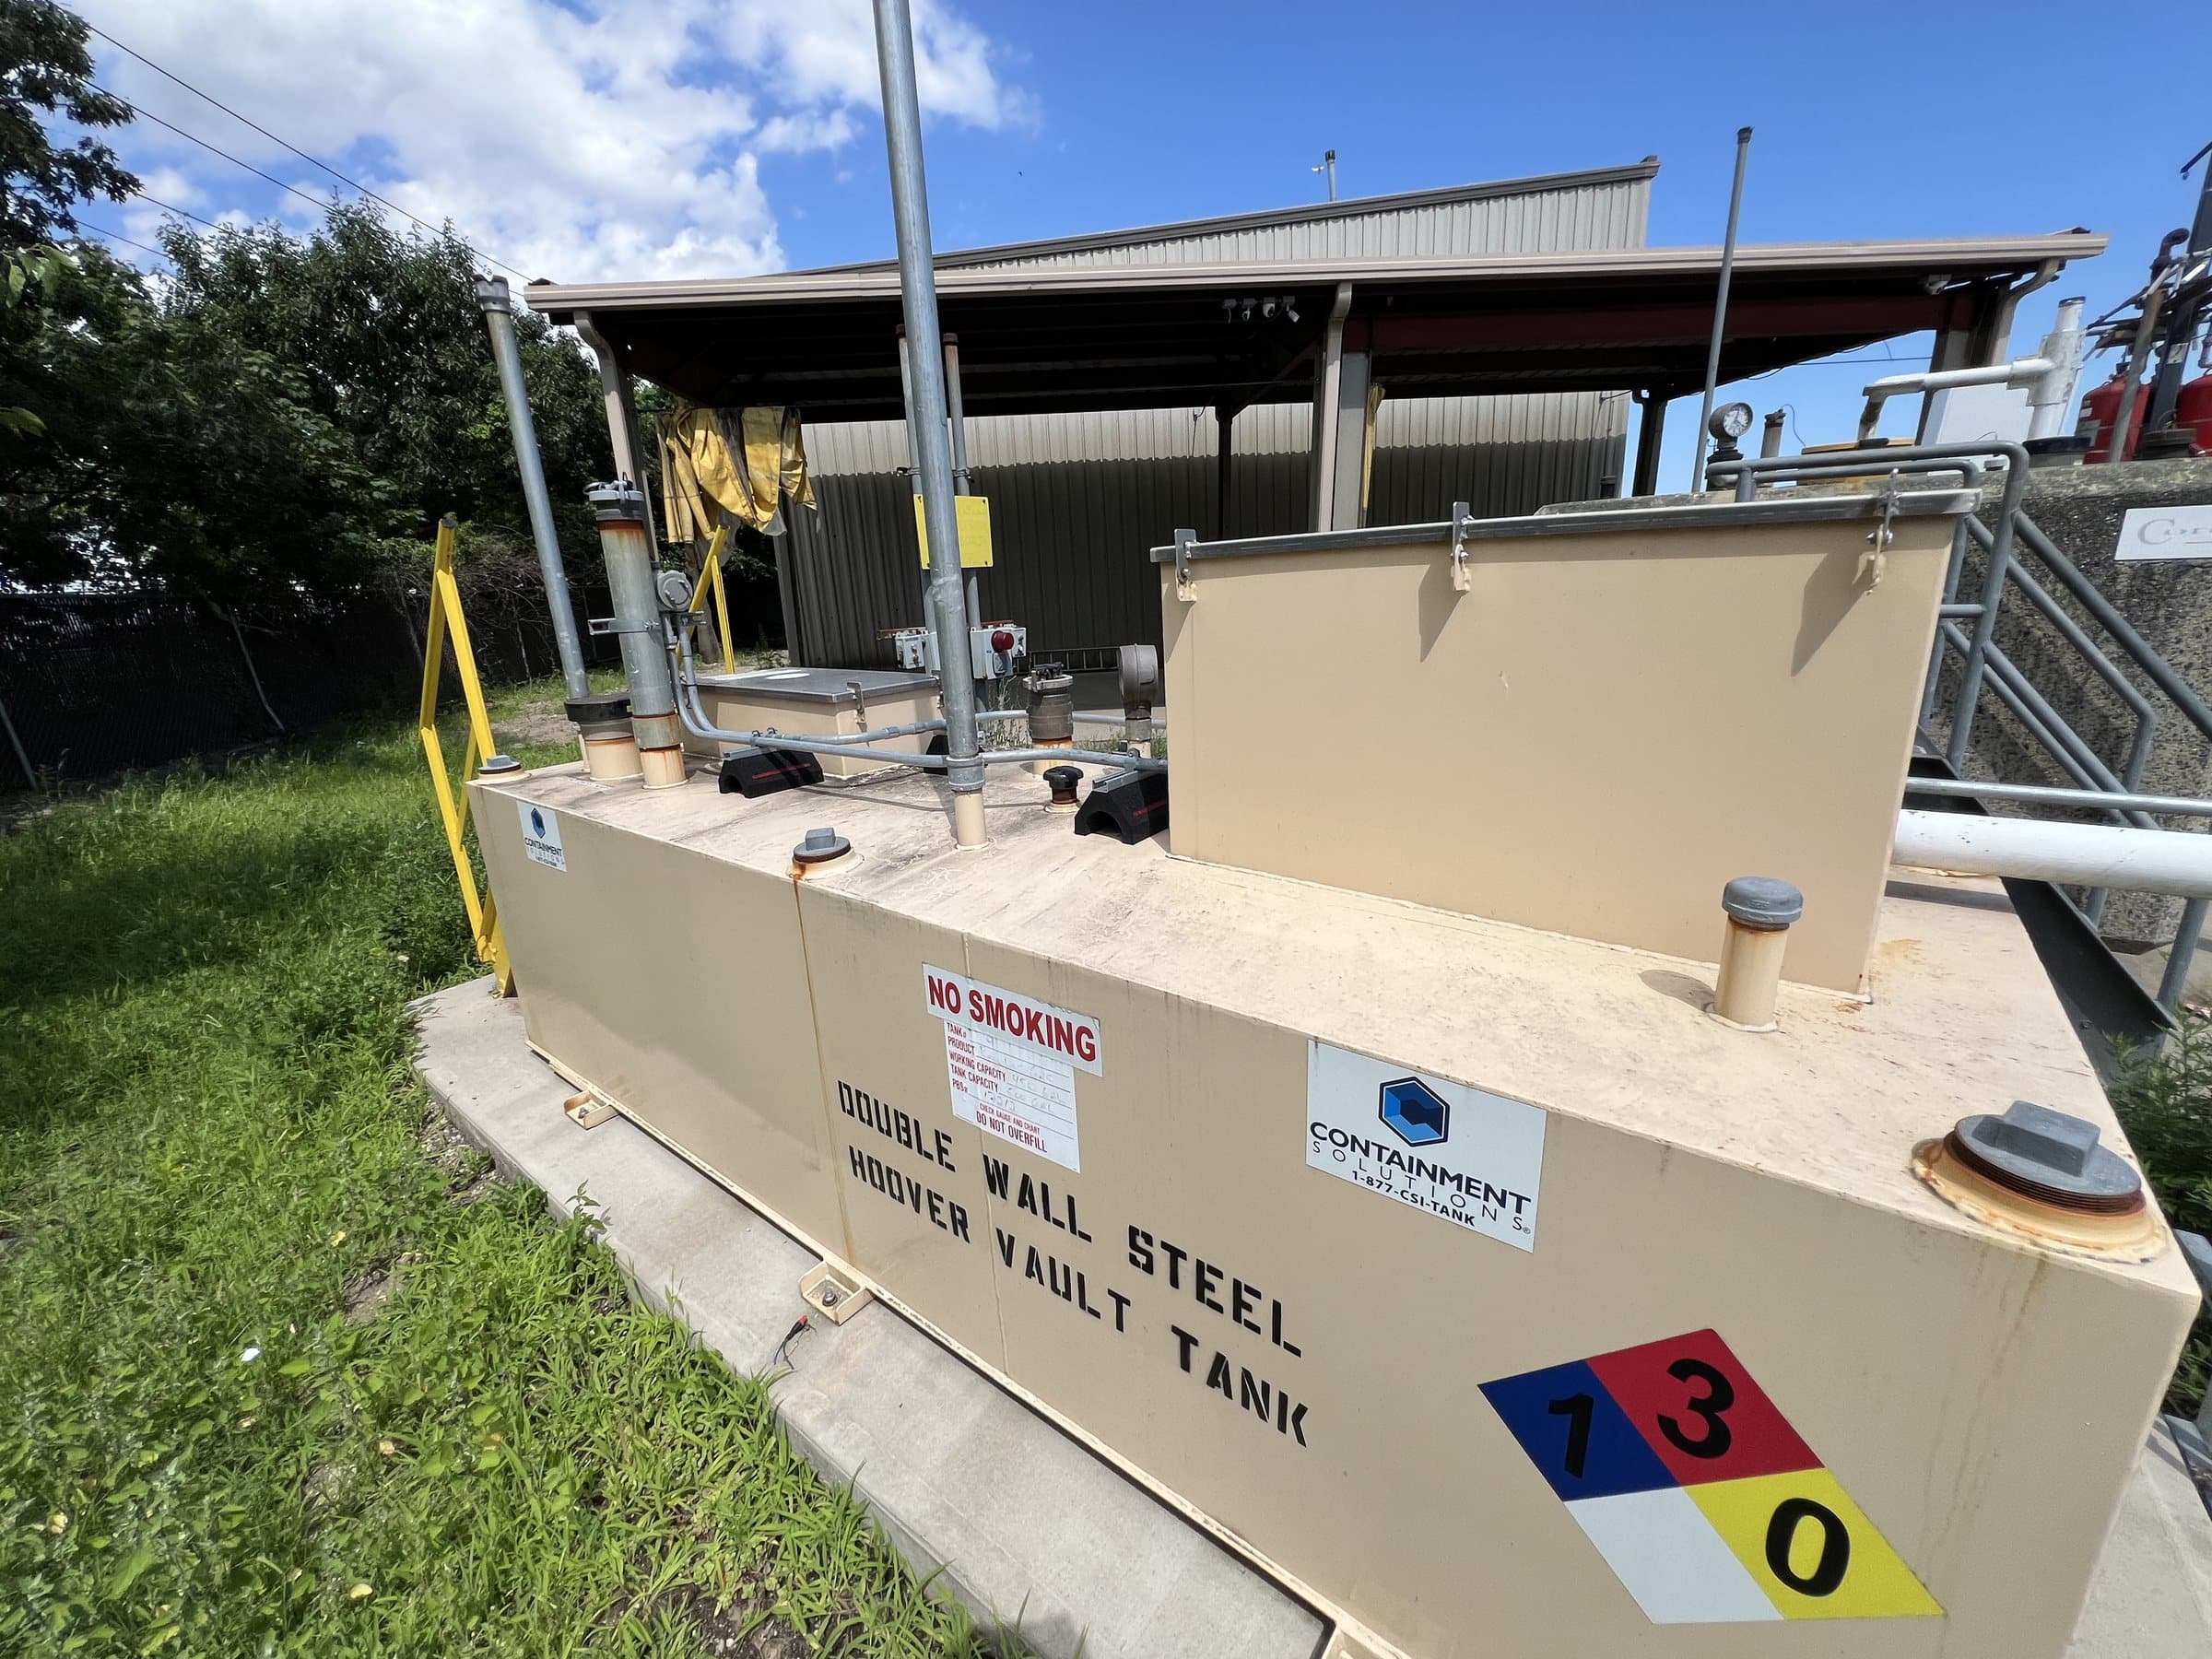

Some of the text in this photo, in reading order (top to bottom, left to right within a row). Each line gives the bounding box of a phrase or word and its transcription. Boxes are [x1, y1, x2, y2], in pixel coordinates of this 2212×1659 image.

[928, 975, 1097, 1062] NO SMOKING
[947, 1036, 974, 1055] PRODUCT
[949, 1050, 975, 1070] WORKING
[977, 1062, 1006, 1082] CAPACITY
[950, 1064, 967, 1079] TANK
[969, 1071, 998, 1092] CAPACITY
[976, 1111, 1048, 1153] DO NOT OVERFILL
[980, 1102, 994, 1115] CHECK
[1014, 1117, 1023, 1127] AND
[1024, 1122, 1041, 1135] CHART
[1310, 1122, 1531, 1215] CONTAINMENT
[1352, 1171, 1476, 1227] 1-877-CSI-TANK
[838, 1080, 1301, 1358] DOUBLE WALL STEEL
[849, 1145, 1309, 1448] HOOVER VAULT TANK
[1548, 1393, 1594, 1479] 1
[1656, 1358, 1735, 1459] 3
[1765, 1497, 1851, 1597] 0
